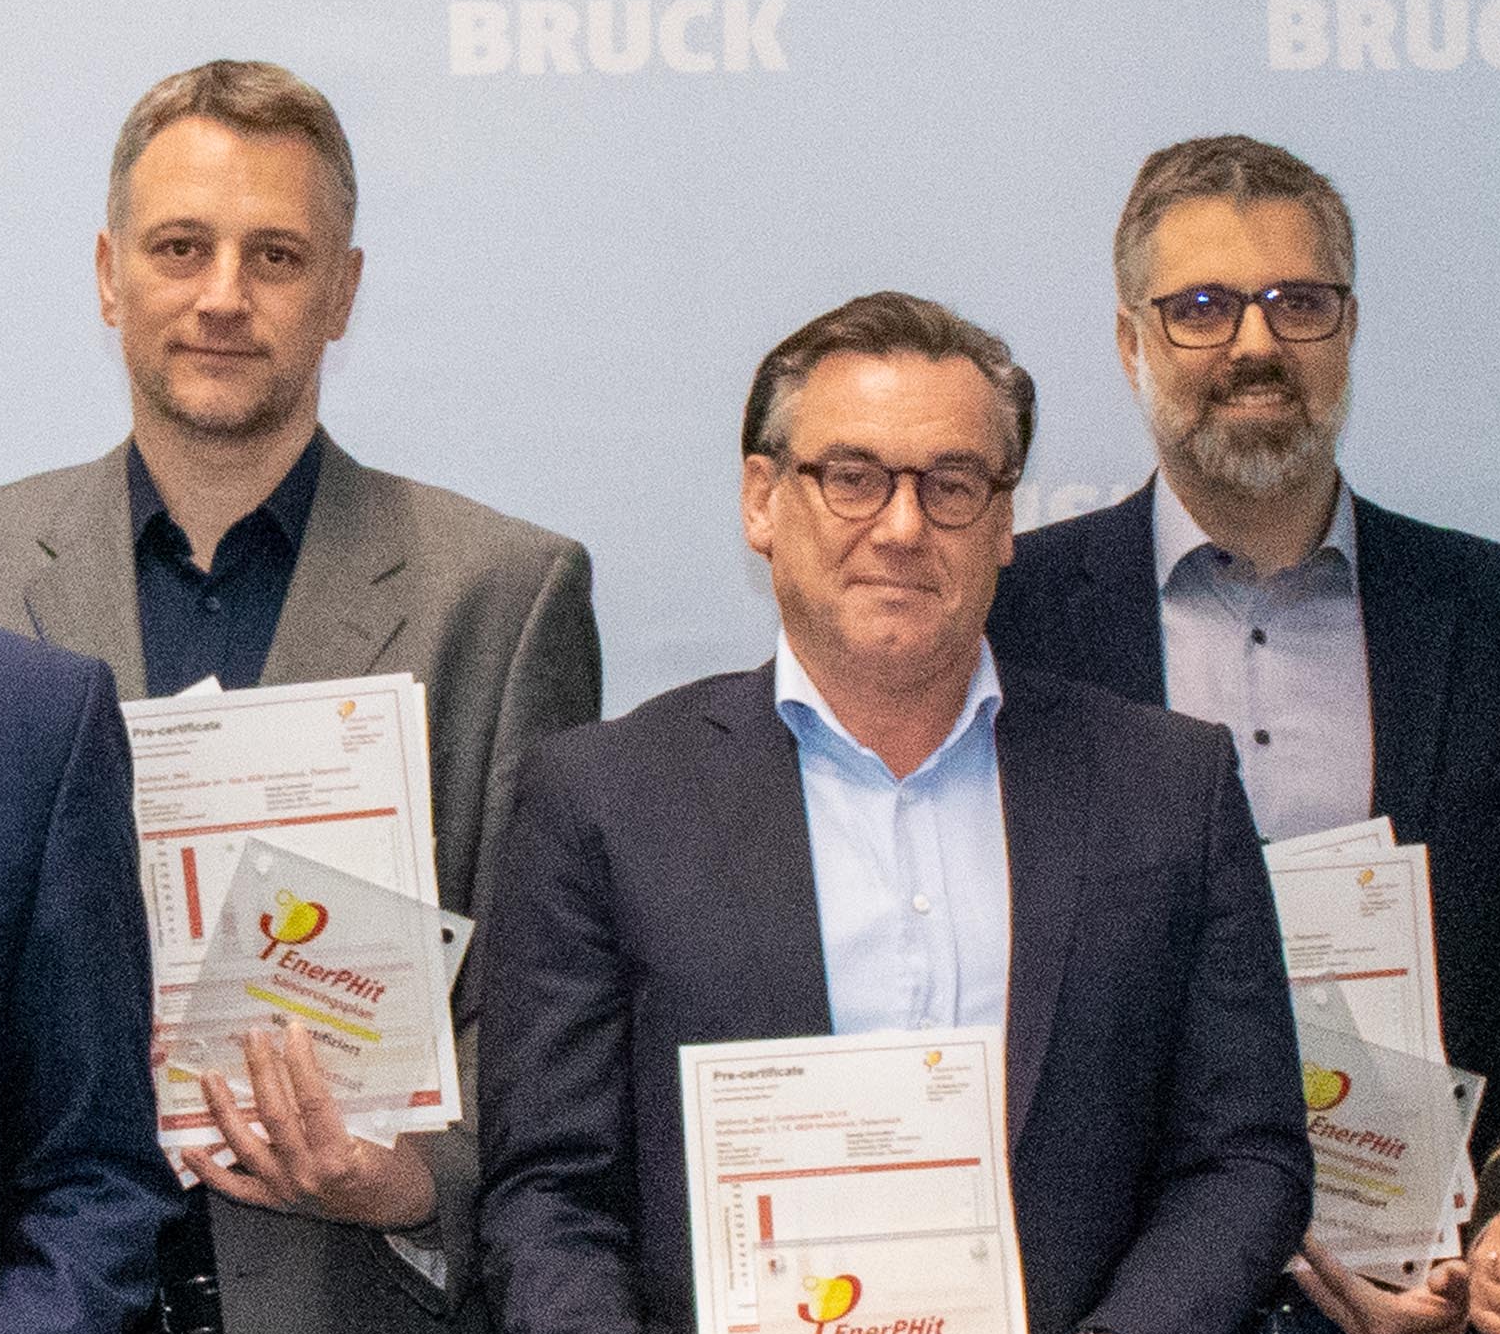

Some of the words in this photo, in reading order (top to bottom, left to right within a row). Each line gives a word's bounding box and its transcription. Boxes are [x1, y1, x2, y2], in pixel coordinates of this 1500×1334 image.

[132, 719, 223, 740] Pre-certificate
[277, 949, 387, 1004] EnerPHit
[712, 1064, 806, 1083] Pre-certificate
